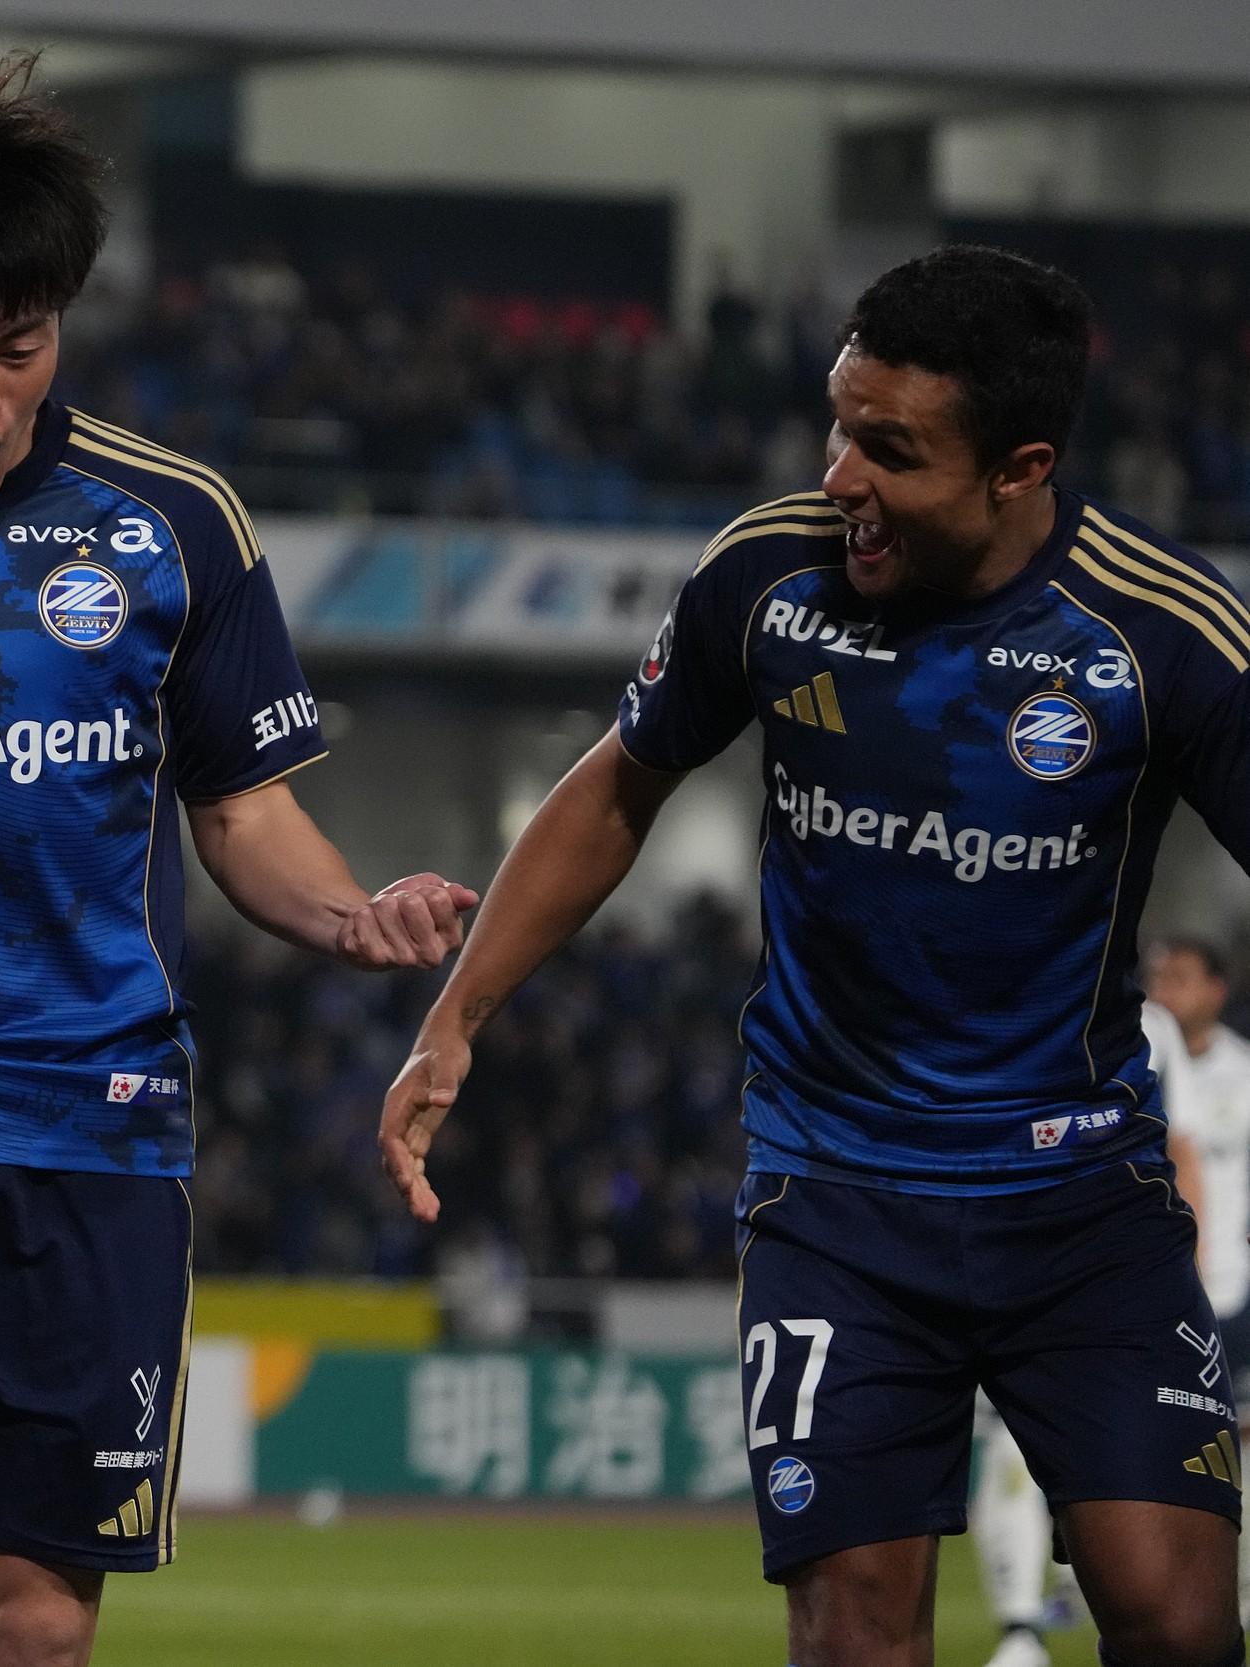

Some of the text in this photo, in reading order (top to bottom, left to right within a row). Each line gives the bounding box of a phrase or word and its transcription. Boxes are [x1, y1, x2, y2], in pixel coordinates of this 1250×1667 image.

[7, 525, 99, 544] avex
[762, 599, 898, 661] RUDEL
[987, 647, 1078, 675] avex
[149, 1077, 180, 1095] 天皇杯
[745, 1319, 835, 1451] 27
